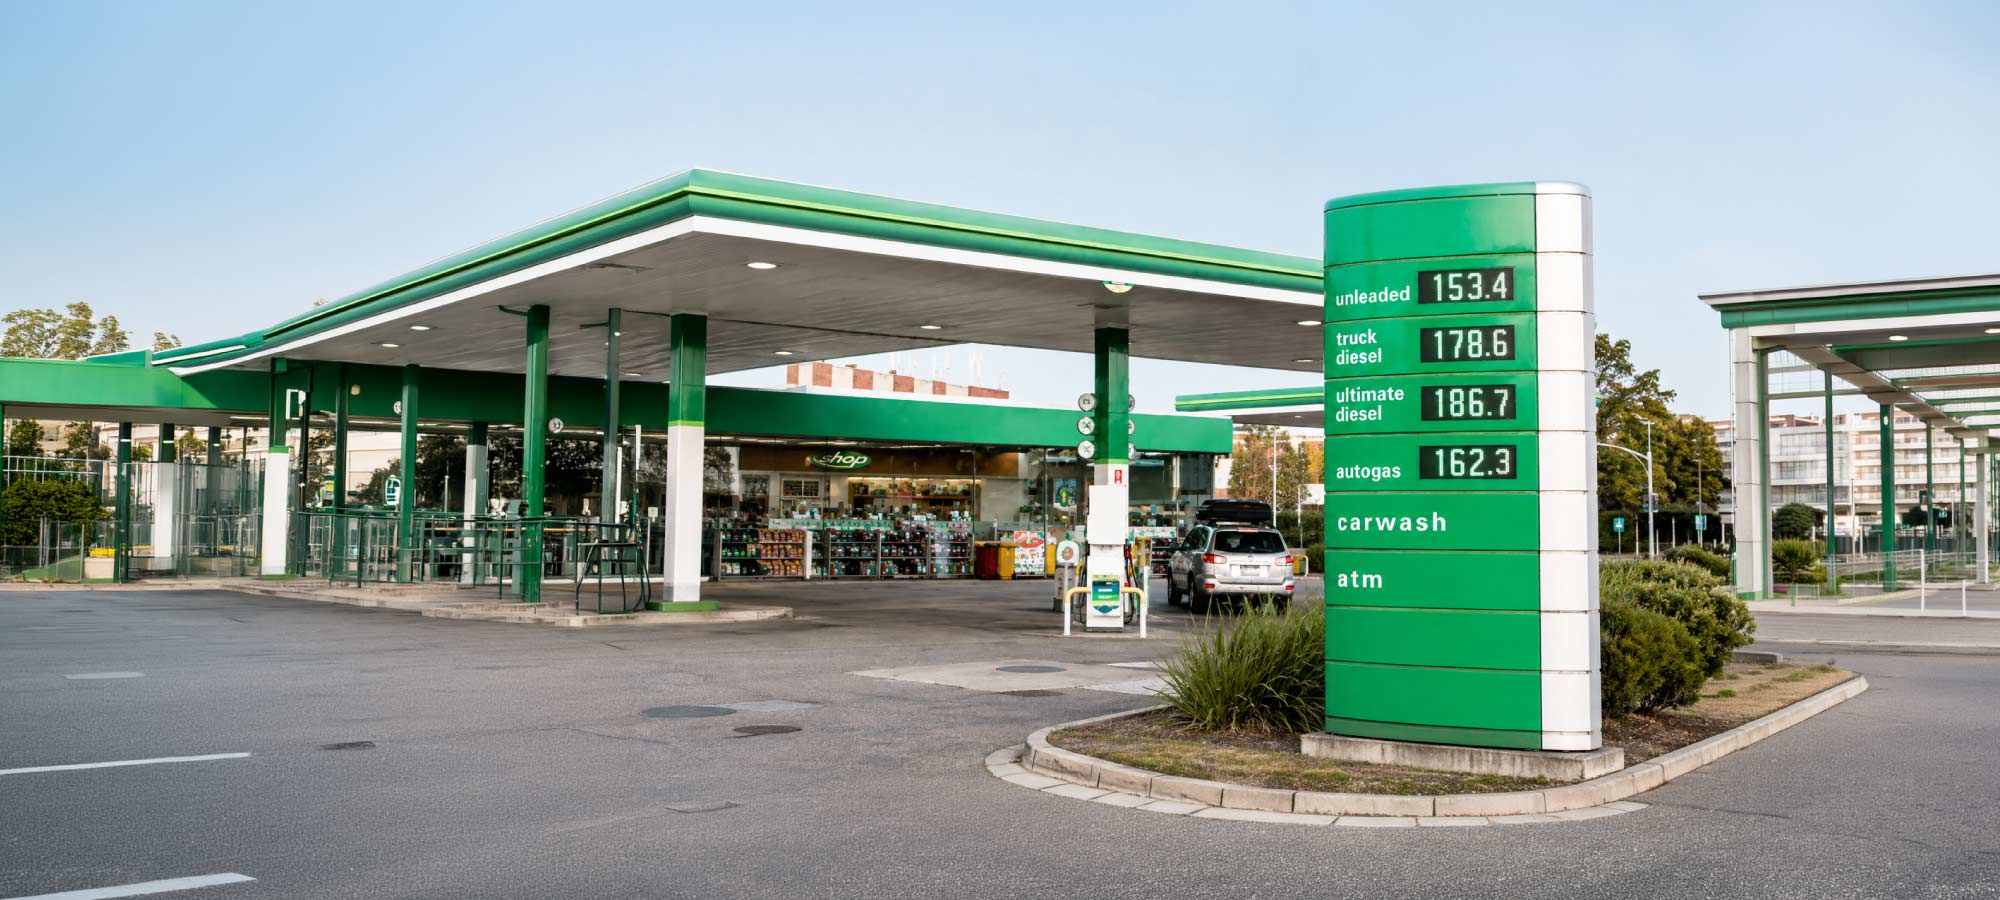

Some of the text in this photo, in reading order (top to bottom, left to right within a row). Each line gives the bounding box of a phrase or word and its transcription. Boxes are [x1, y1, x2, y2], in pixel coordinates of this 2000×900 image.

[1336, 272, 1508, 306] unleaded 153.4
[1336, 328, 1377, 345] truck
[1434, 328, 1508, 359] 178.6
[1336, 348, 1382, 365] diesel
[1336, 386, 1404, 403] ultimate
[1435, 388, 1509, 418] 186.7
[1336, 405, 1382, 422] diesel
[820, 451, 868, 468] shop
[1336, 448, 1510, 481] autogas 162.3
[1337, 512, 1446, 531] carwash
[1337, 571, 1383, 588] atm
